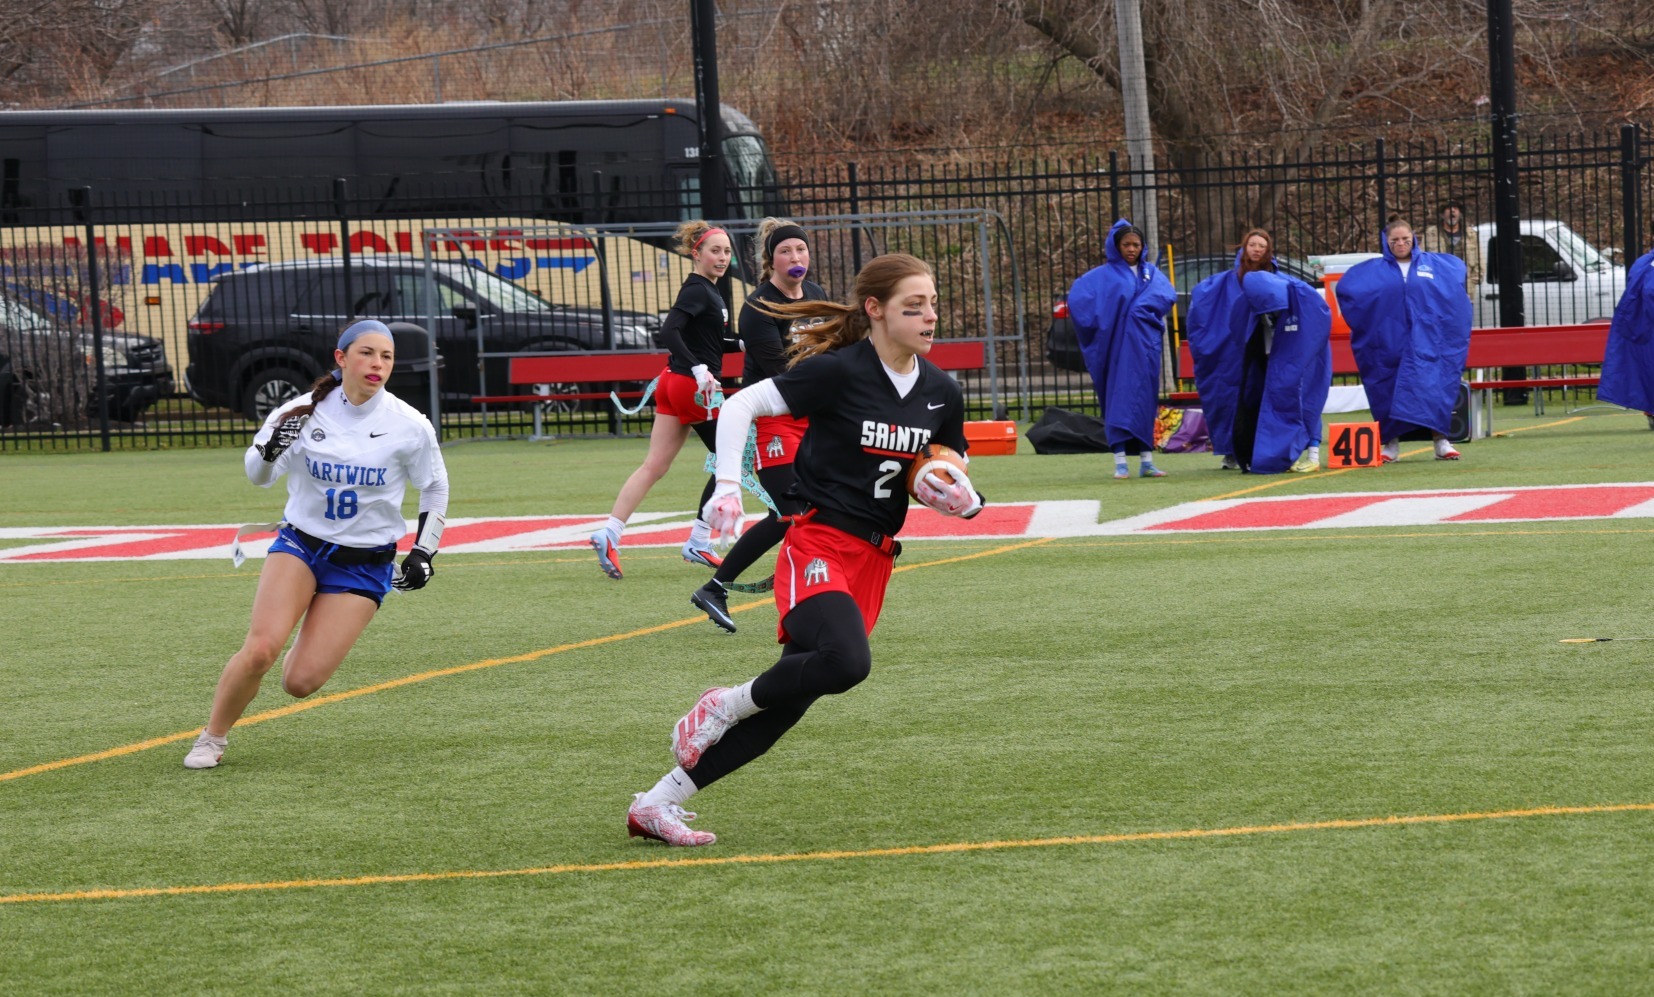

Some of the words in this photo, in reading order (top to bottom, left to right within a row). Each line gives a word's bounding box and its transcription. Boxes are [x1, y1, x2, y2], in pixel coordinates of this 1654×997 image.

[1332, 427, 1374, 466] 40
[874, 460, 902, 499] 2
[324, 488, 358, 521] 18
